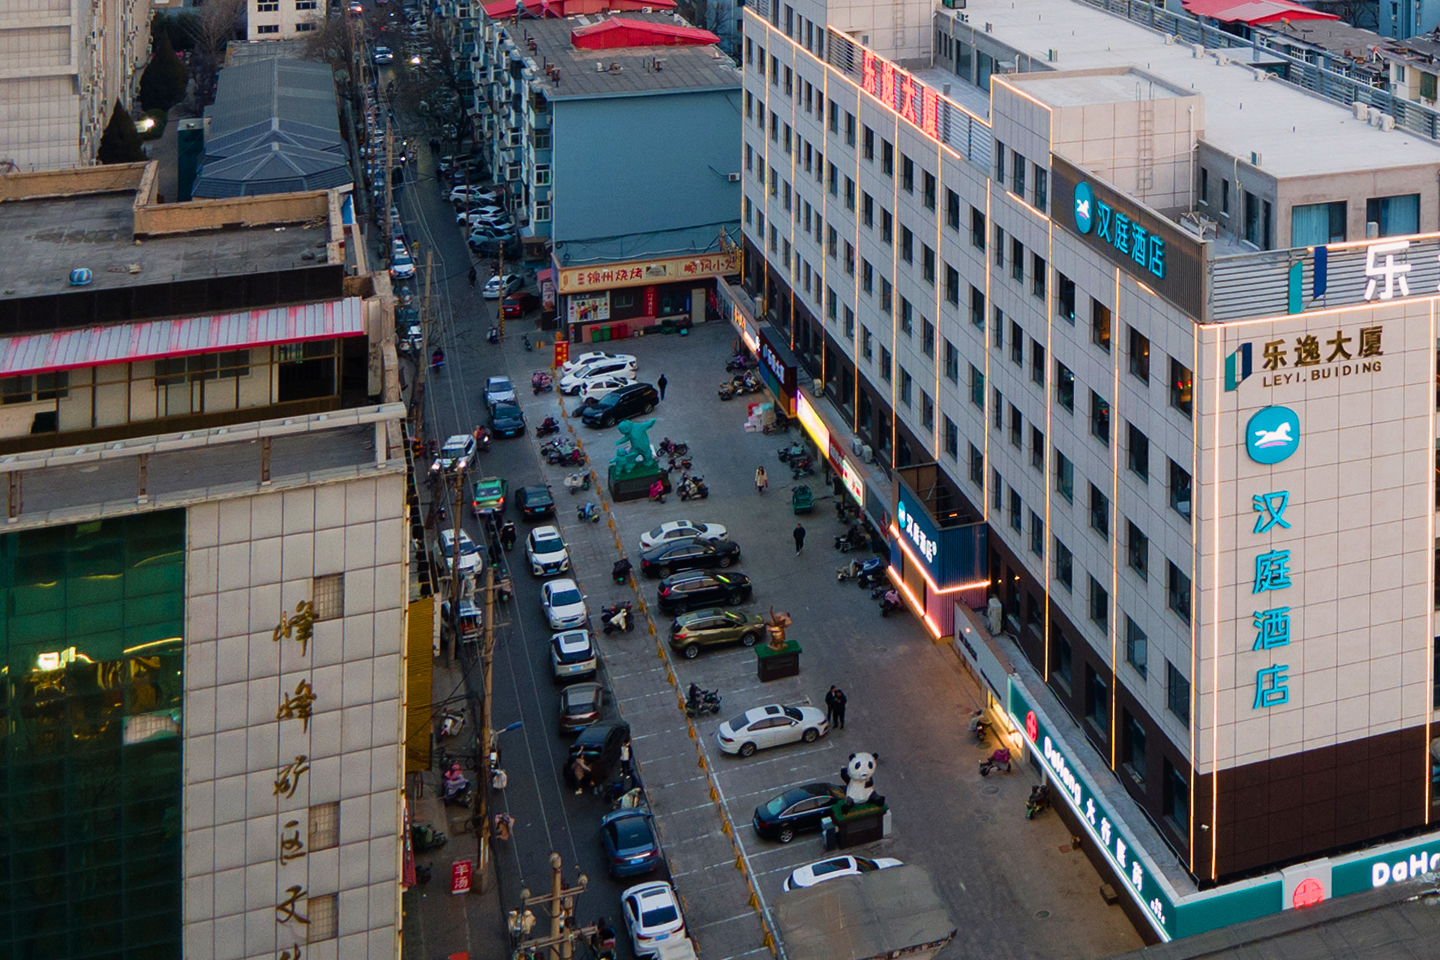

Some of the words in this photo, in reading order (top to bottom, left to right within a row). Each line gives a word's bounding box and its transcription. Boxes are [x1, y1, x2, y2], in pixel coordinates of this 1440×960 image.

[863, 50, 939, 139] 乐逸大厦
[1096, 200, 1166, 279] 汉庭酒店
[1262, 325, 1385, 371] 乐逸大厦
[1252, 490, 1292, 710] 汉庭酒店
